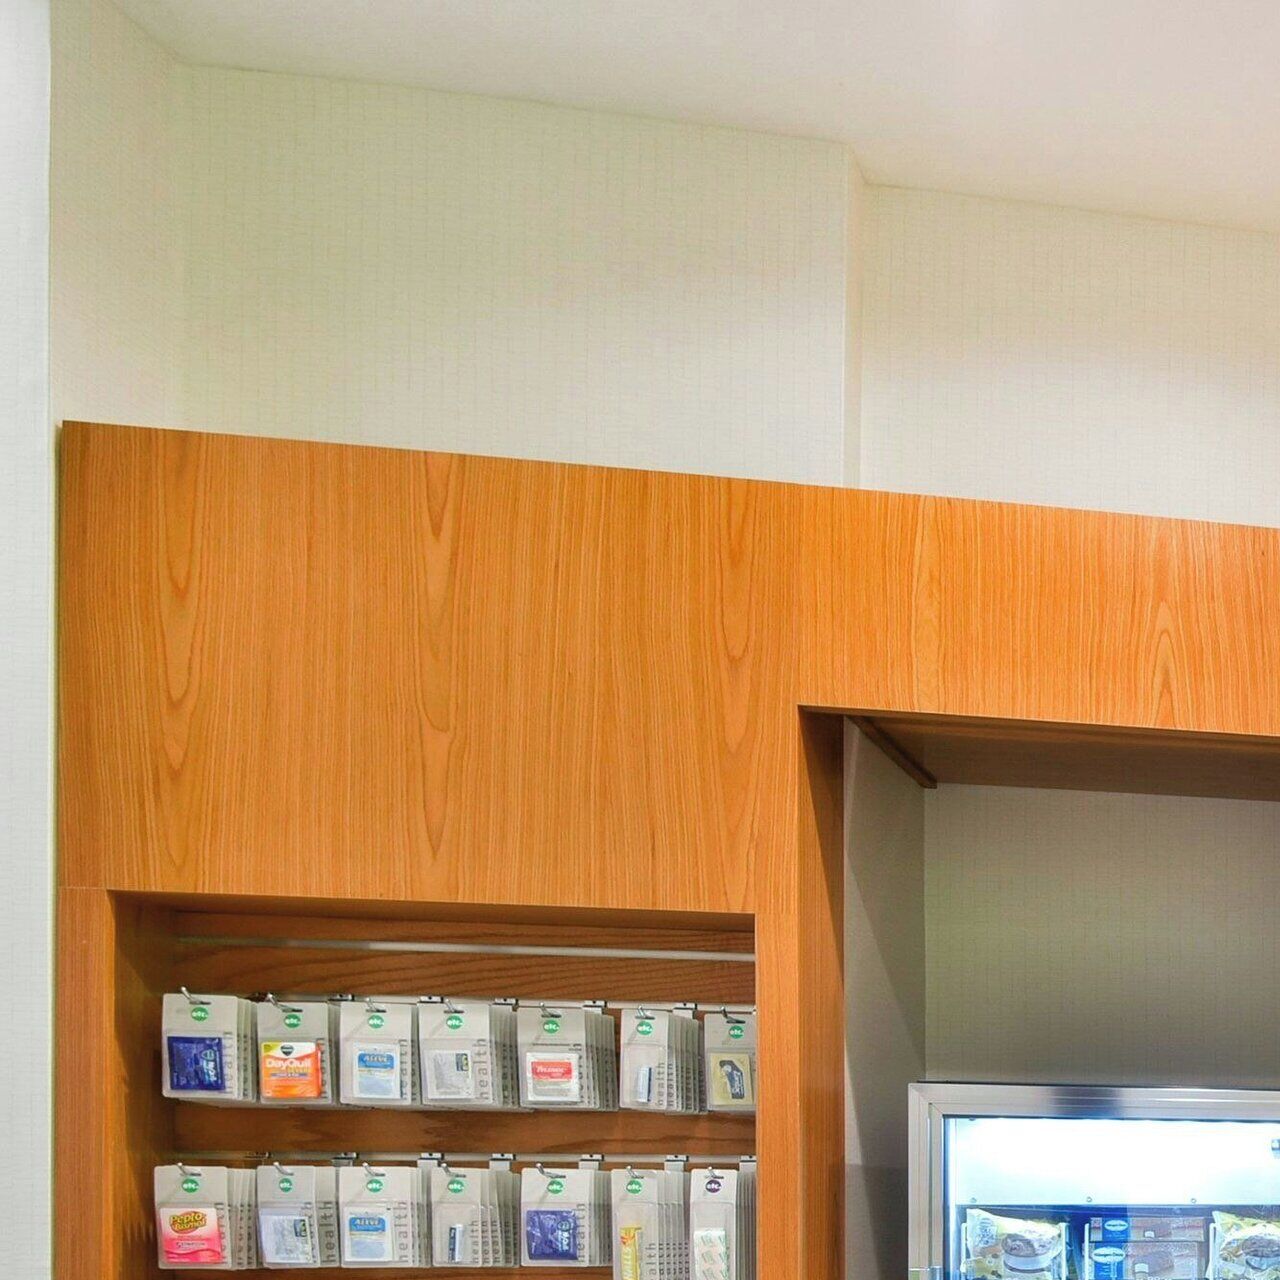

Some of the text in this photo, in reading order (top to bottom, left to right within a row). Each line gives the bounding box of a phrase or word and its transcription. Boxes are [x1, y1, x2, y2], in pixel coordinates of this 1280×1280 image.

[265, 1058, 312, 1071] DayQuil
[473, 1038, 489, 1099] health
[319, 1201, 336, 1264] health
[393, 1201, 409, 1263] health
[470, 1220, 480, 1264] health
